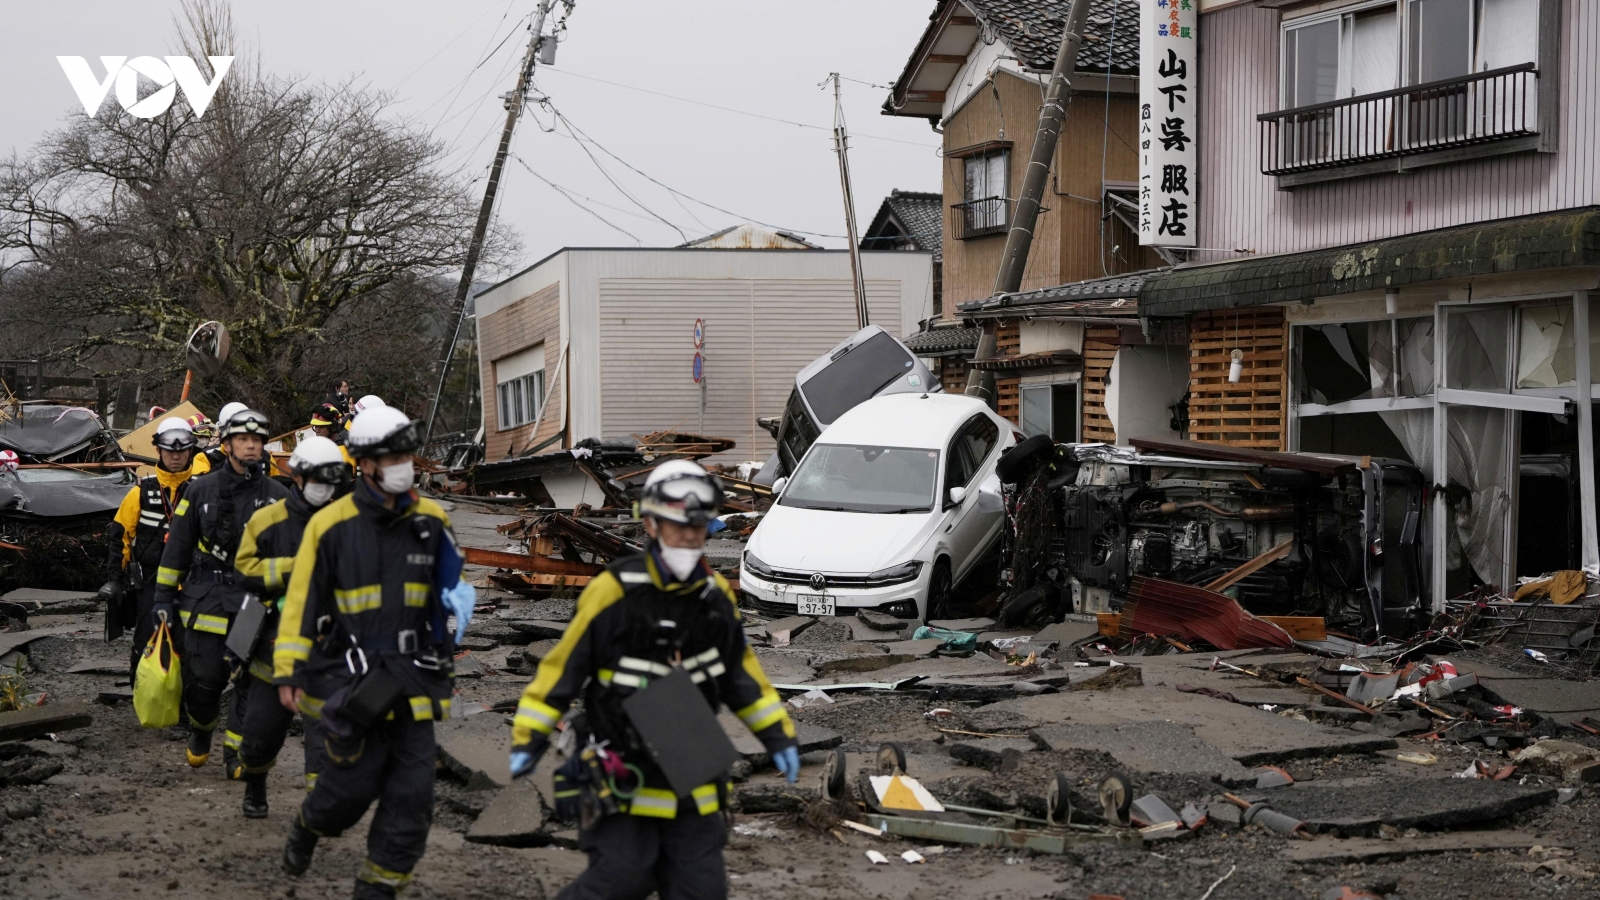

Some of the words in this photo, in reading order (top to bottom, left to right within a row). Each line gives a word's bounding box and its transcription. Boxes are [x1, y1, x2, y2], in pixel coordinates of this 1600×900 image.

[1158, 48, 1191, 236] 山下呉服店
[806, 603, 833, 614] 97-97
